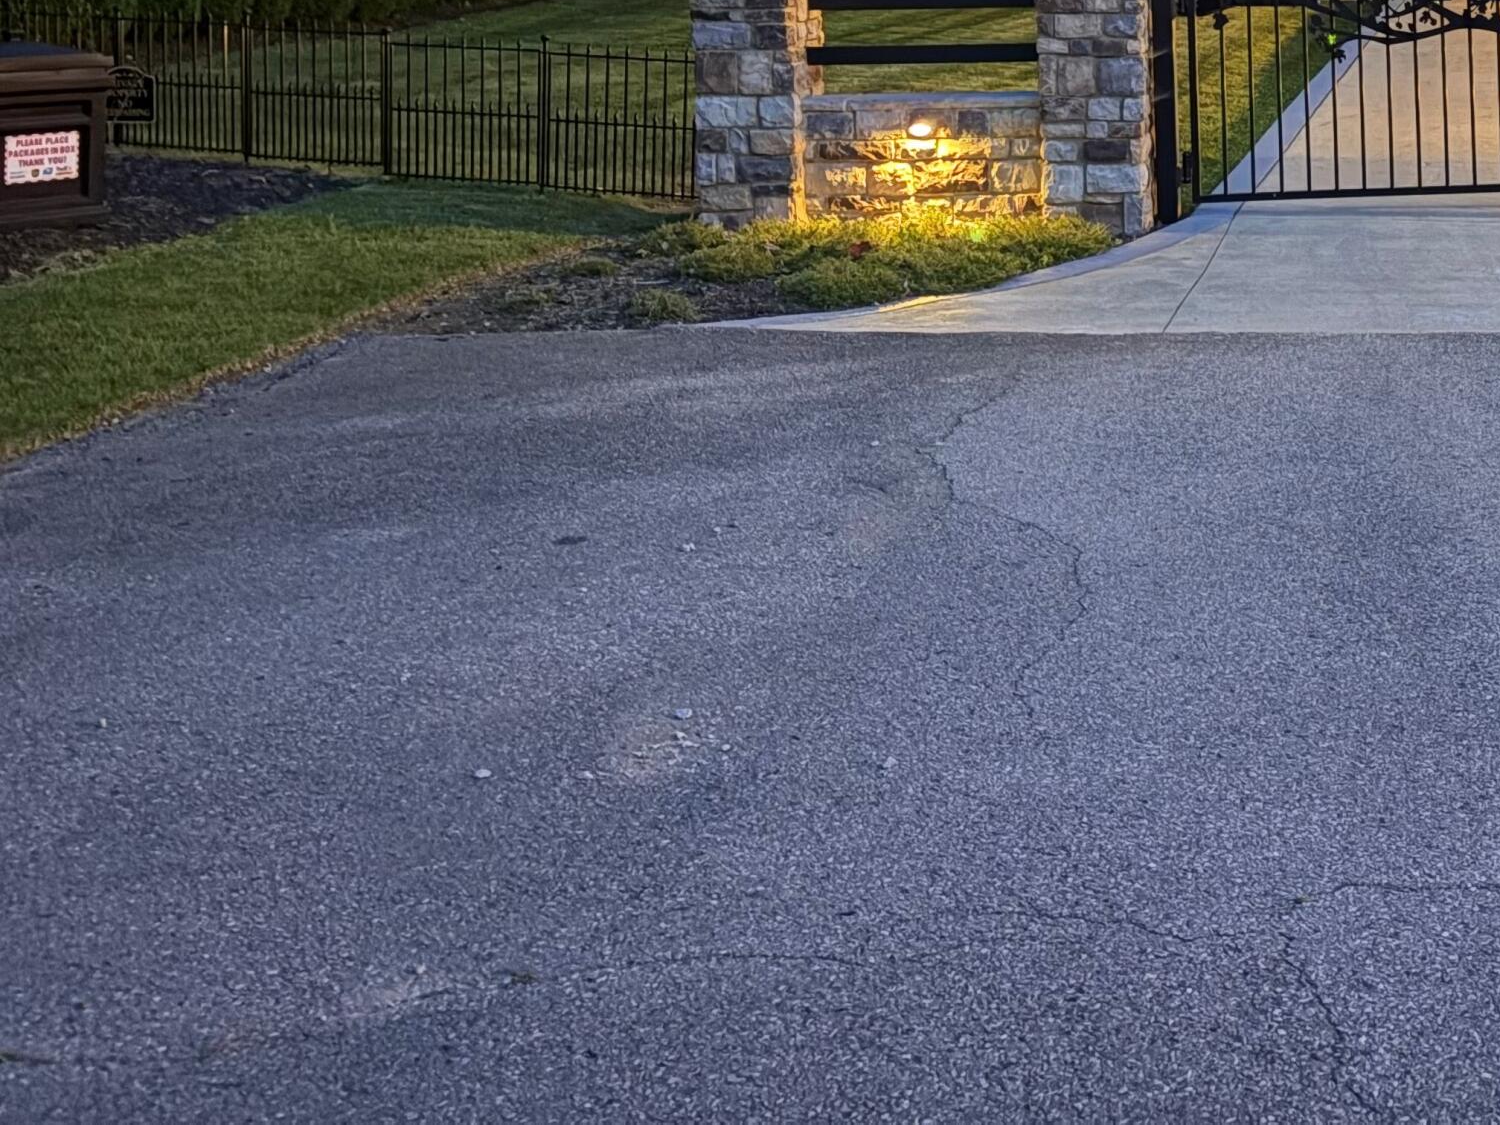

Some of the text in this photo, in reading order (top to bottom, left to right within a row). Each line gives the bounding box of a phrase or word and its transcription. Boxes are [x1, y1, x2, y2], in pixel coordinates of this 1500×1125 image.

[16, 136, 69, 147] PLEASE PLACE
[8, 148, 49, 157] PACKAGES
[60, 146, 75, 154] BOX
[18, 158, 45, 167] THANK
